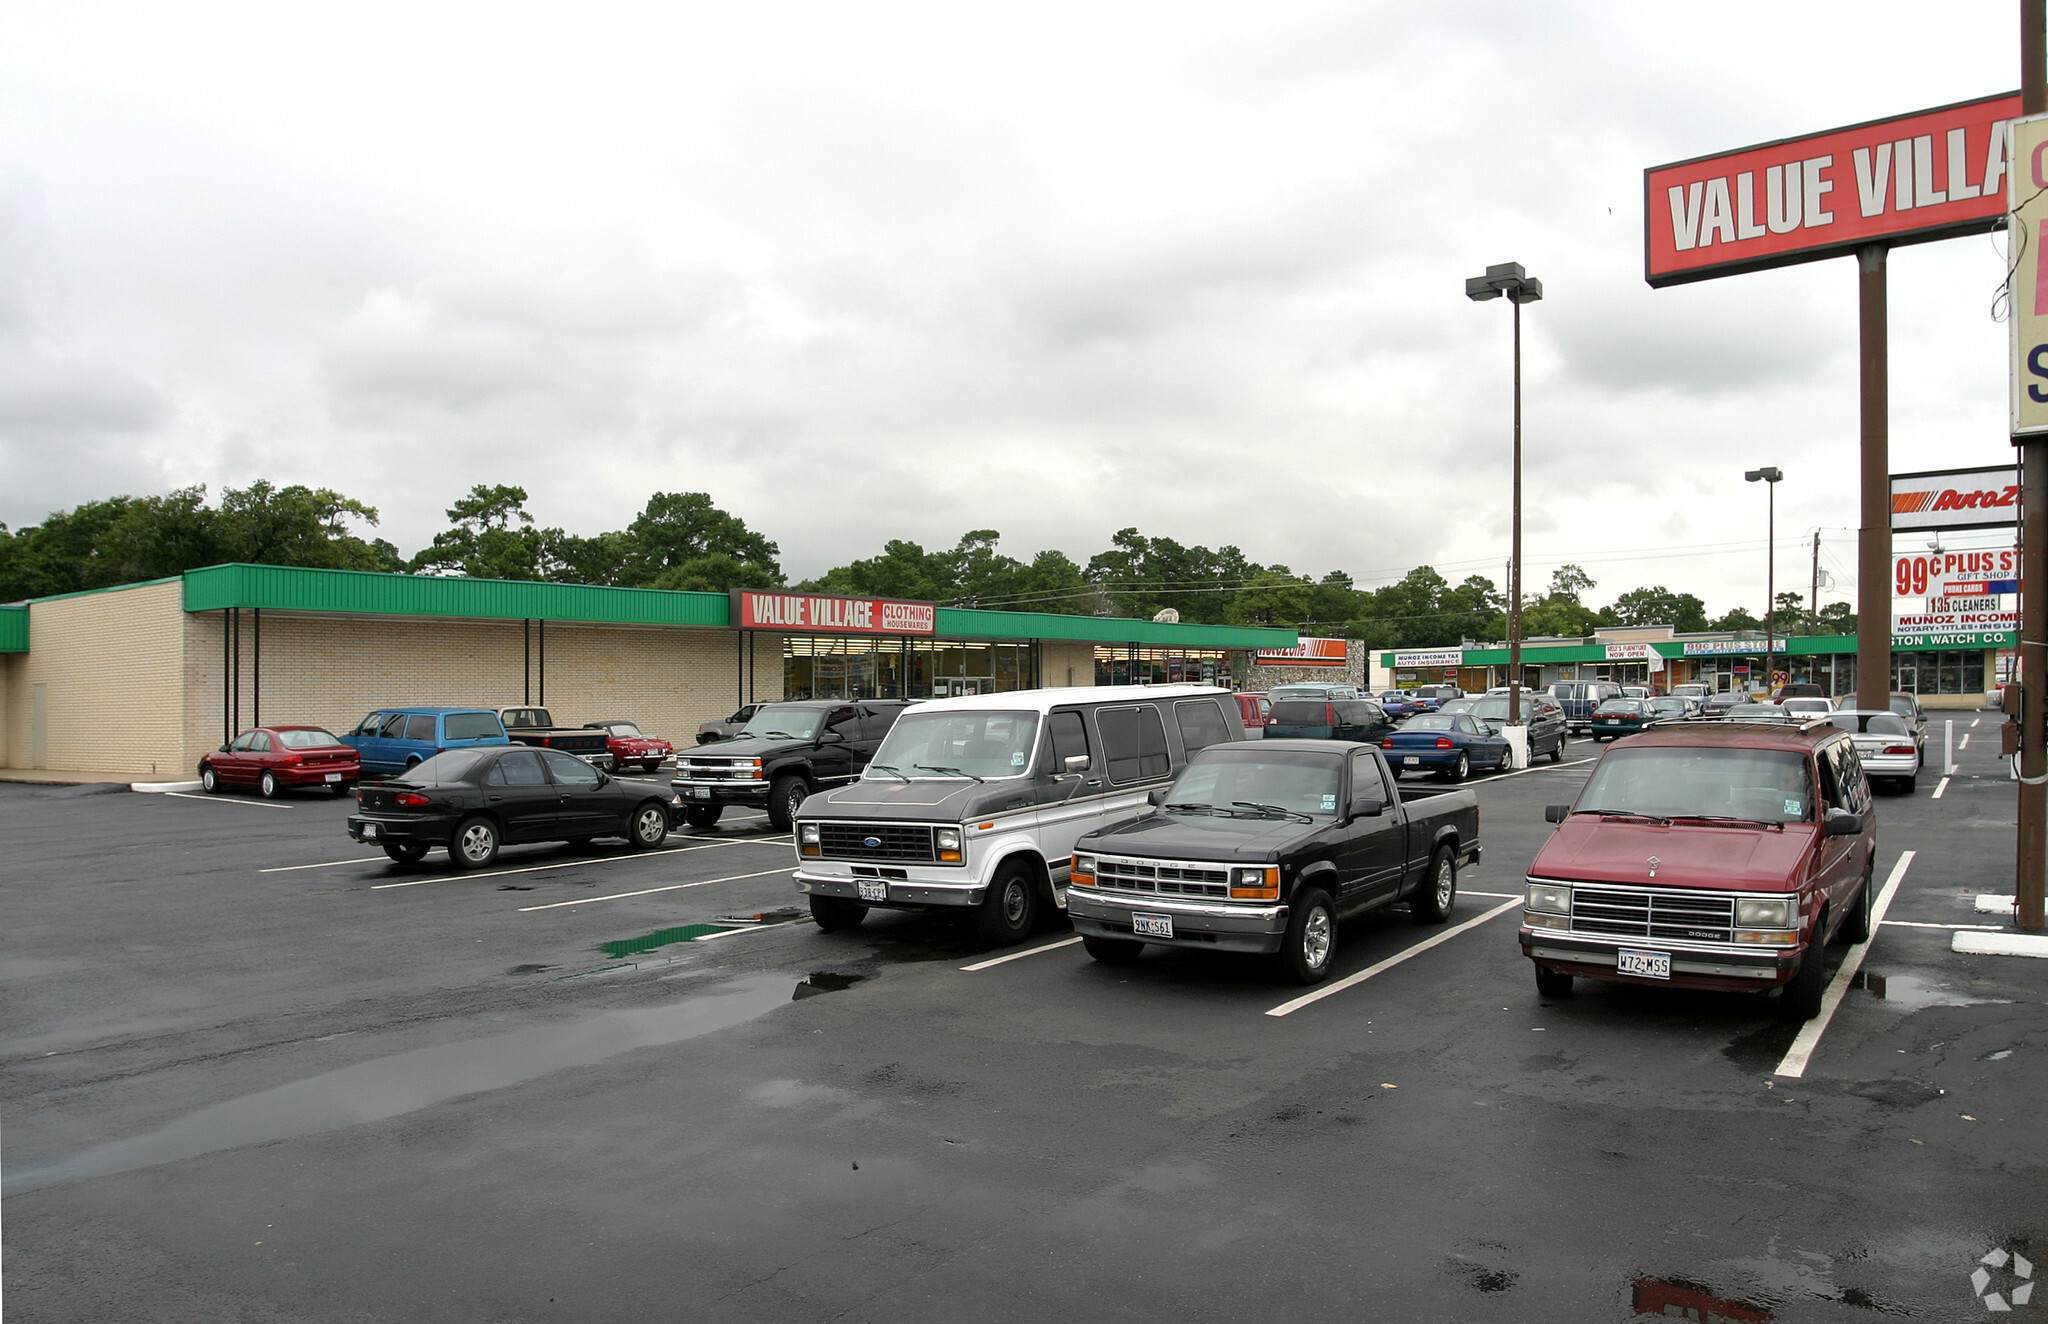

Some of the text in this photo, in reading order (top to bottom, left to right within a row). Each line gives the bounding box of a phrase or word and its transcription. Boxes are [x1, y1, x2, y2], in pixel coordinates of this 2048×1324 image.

[1667, 154, 1834, 251] VALUE
[1945, 552, 1994, 573] PLUS
[1983, 571, 2010, 580] SHOP
[1944, 584, 1983, 593] PHONE CARDS
[752, 594, 873, 628] VALUE VILLAGE
[1952, 599, 1996, 612] CLEANERS
[884, 605, 932, 621] CLOTHING
[887, 620, 928, 629] HOUSEWARES
[1900, 614, 1955, 625] MUÑOZ
[1897, 625, 1934, 633] NOTARY
[1713, 641, 1741, 650] PLUS
[1744, 639, 1782, 649] STOE
[1930, 634, 1976, 645] WATCH
[1983, 633, 2006, 643] CO.
[1688, 931, 1720, 939] DODGE
